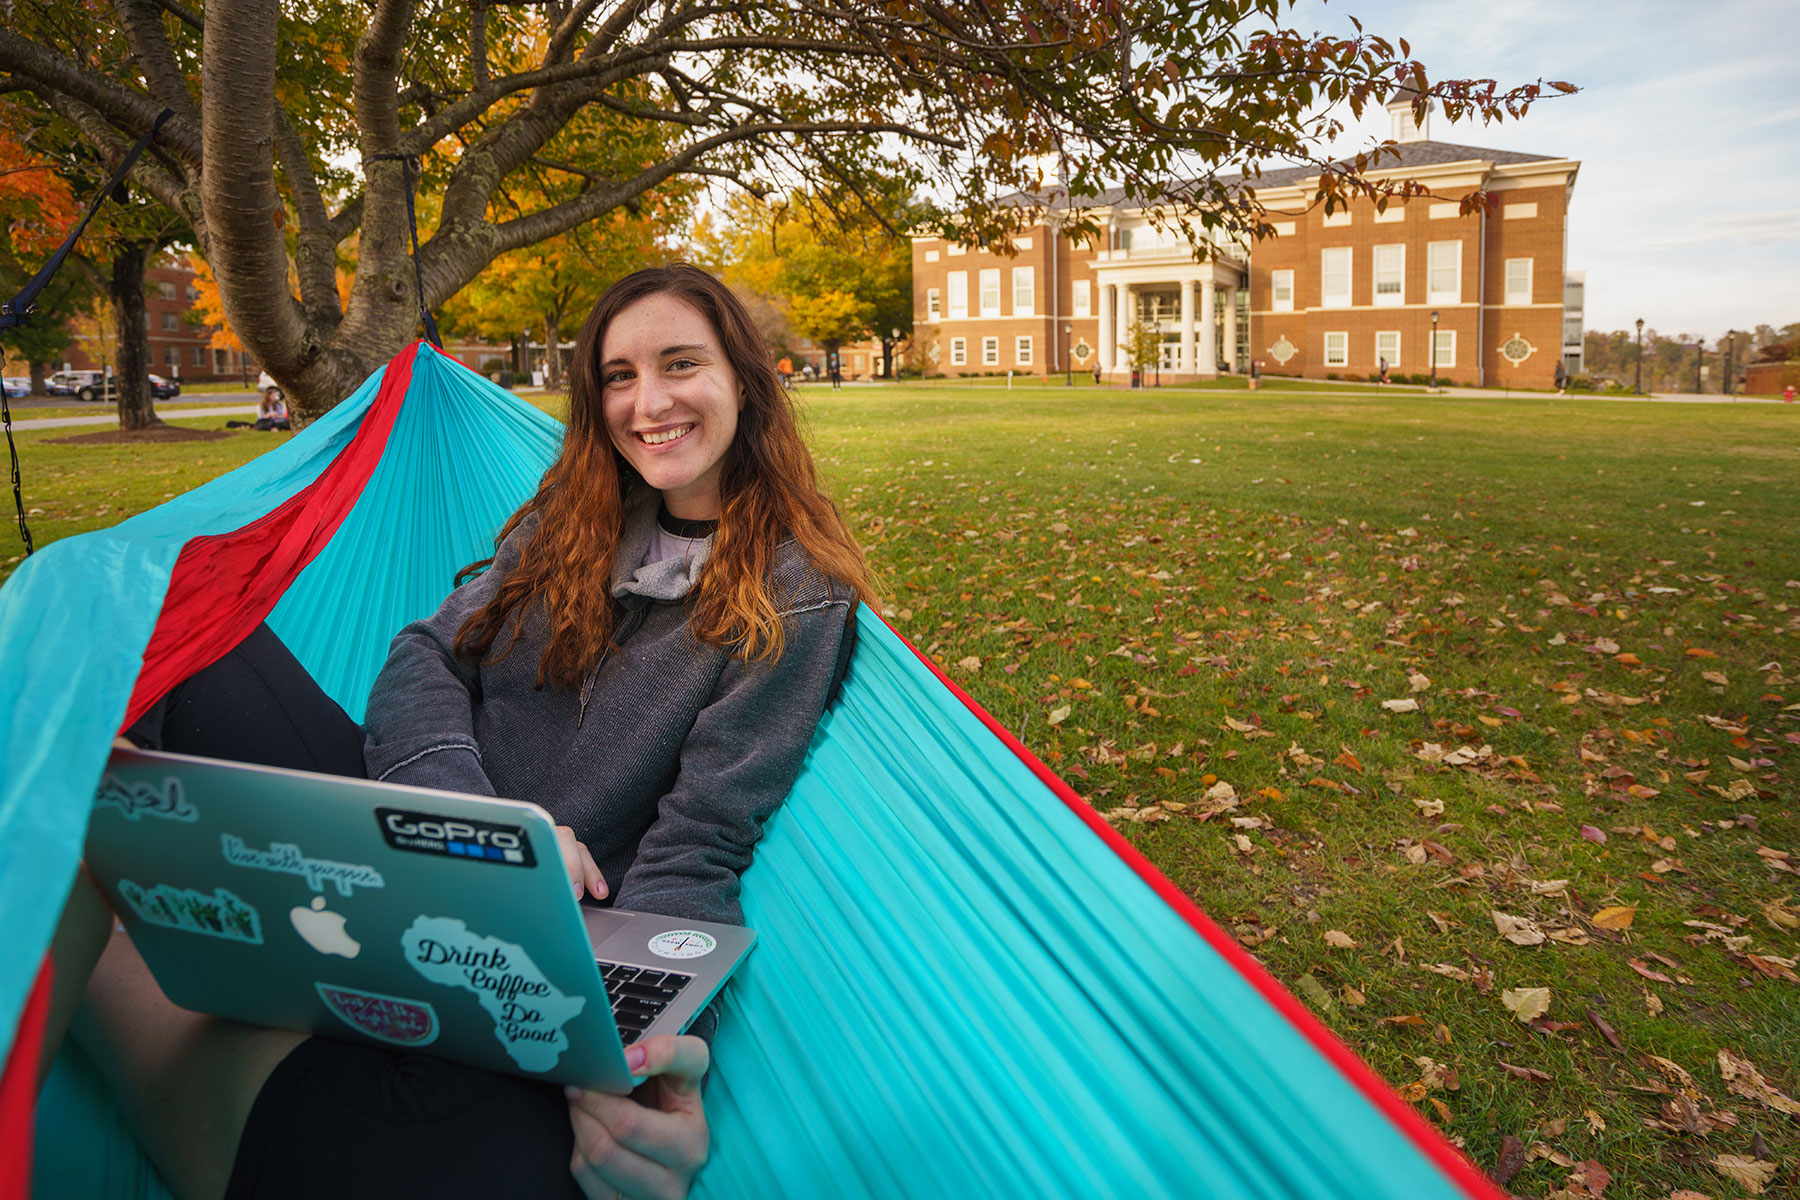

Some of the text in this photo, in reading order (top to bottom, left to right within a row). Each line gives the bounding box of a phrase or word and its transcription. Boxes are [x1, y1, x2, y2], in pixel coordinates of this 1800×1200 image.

[386, 814, 520, 849] GoPro
[418, 938, 510, 971] Drink
[464, 968, 552, 1000] Coffee
[501, 1002, 545, 1023] Do
[500, 1023, 558, 1043] Good
